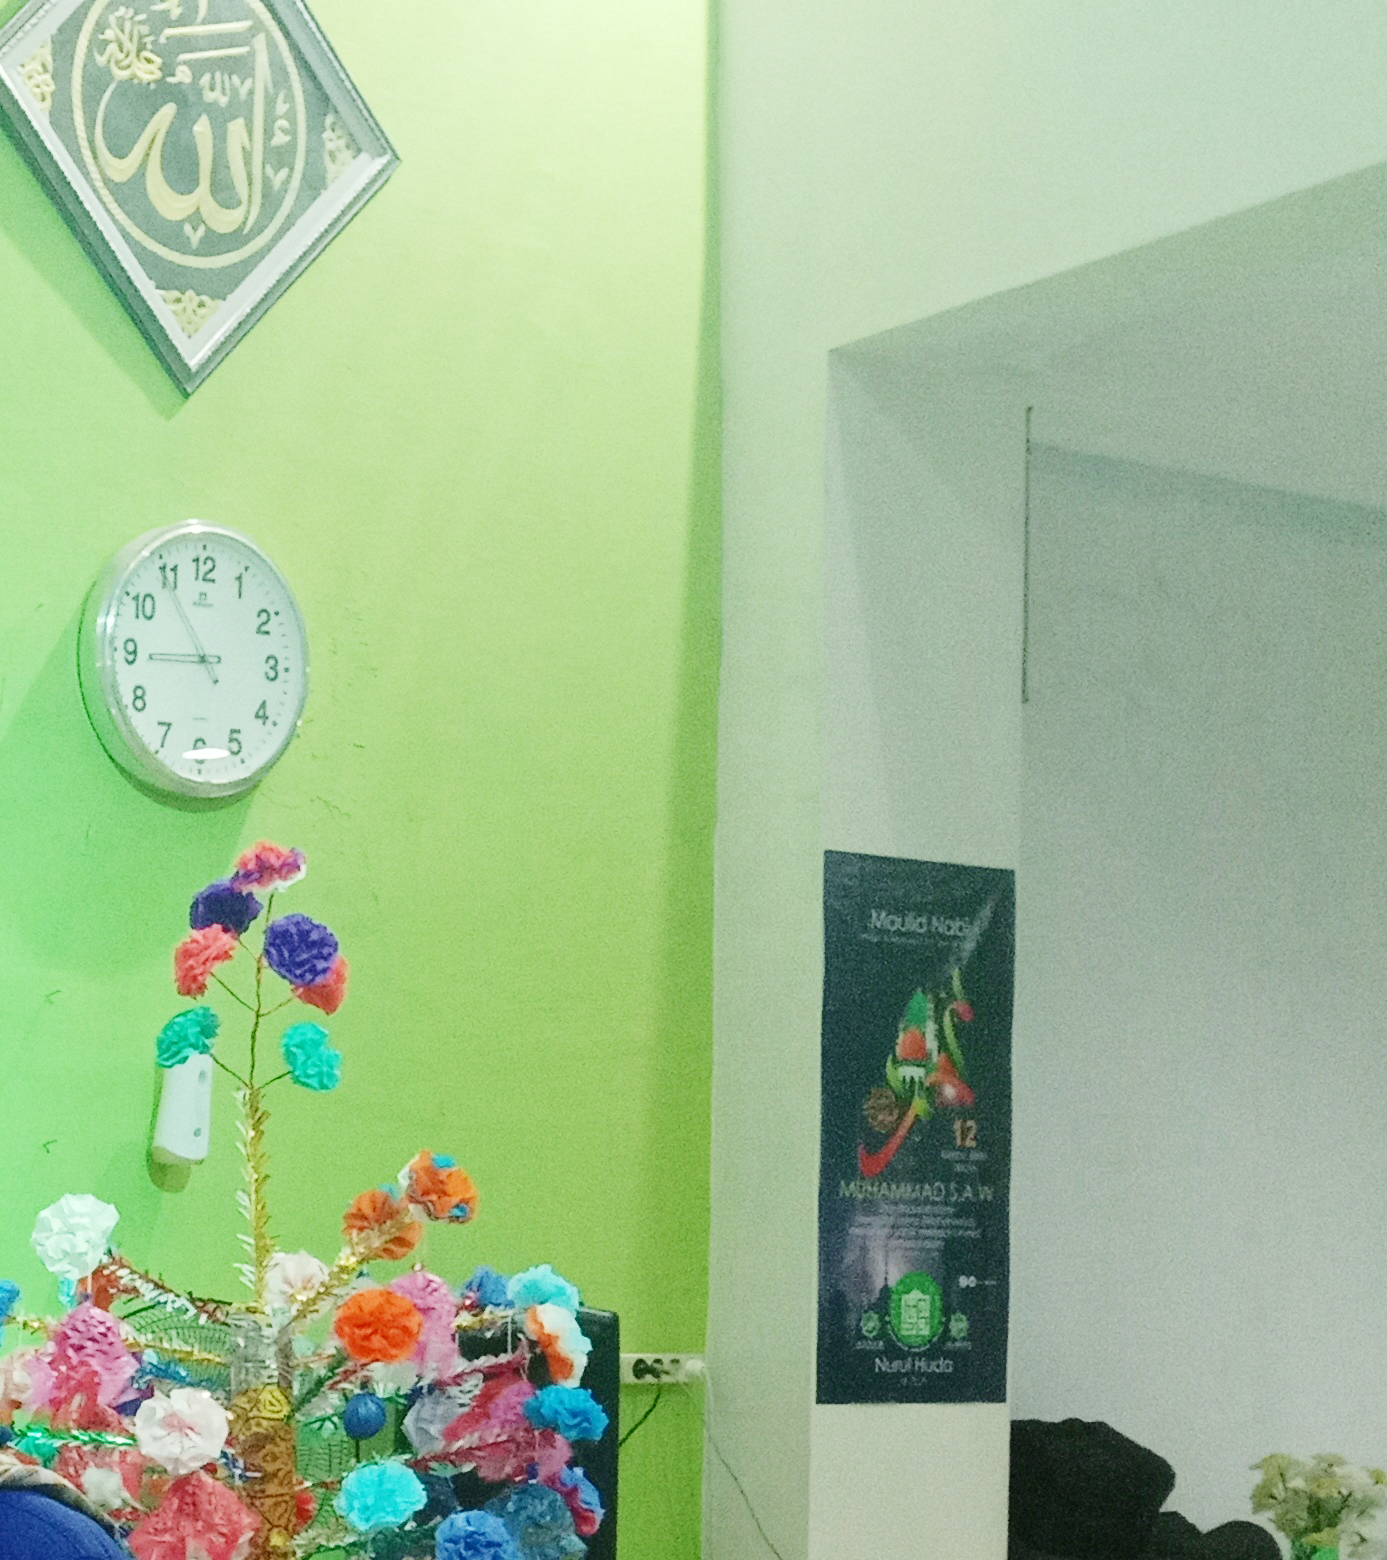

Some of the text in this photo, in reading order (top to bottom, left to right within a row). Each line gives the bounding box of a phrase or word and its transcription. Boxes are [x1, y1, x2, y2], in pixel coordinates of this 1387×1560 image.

[159, 562, 178, 591] 11
[192, 556, 216, 583] 12
[235, 572, 243, 599] 1
[132, 593, 156, 620] 10
[256, 609, 271, 635] 2
[123, 638, 138, 665] 9
[264, 655, 279, 681] 3
[132, 685, 147, 712] 8
[254, 700, 269, 726] 4
[157, 721, 172, 748] 7
[228, 729, 242, 755] 5
[953, 1119, 978, 1148] 12
